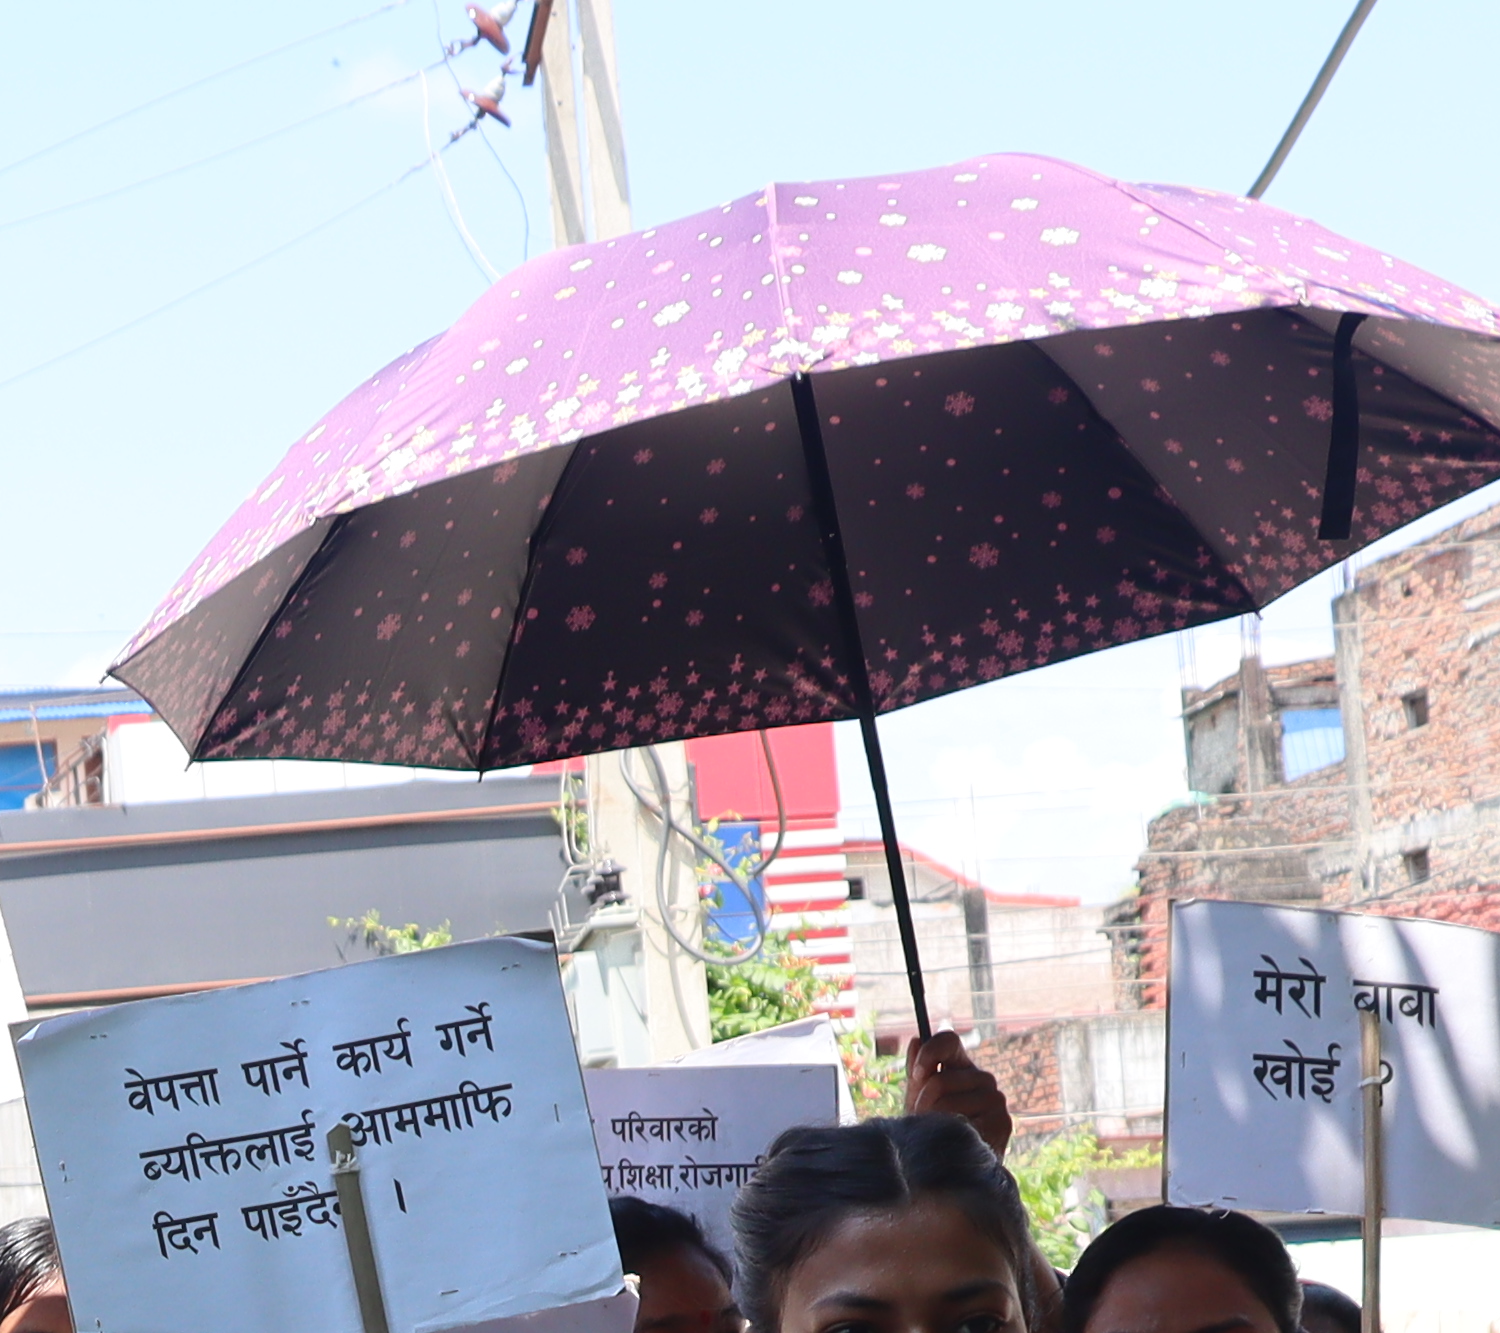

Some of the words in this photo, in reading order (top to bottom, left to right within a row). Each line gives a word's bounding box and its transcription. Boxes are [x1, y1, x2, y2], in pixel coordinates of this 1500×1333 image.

[1254, 954, 1326, 1018] मेरो
[1353, 978, 1440, 1028] बाबा
[124, 1068, 220, 1115] वेपत्ता
[241, 1038, 309, 1096] पार्ने
[332, 1017, 413, 1077] कार्य
[435, 1002, 494, 1056] गर्ने
[1253, 1039, 1341, 1103] खोई
[341, 1080, 513, 1147] आममाफि
[611, 1108, 719, 1143] परिवारको
[152, 1210, 220, 1259] दिन
[241, 1181, 341, 1241] पाइँदै
